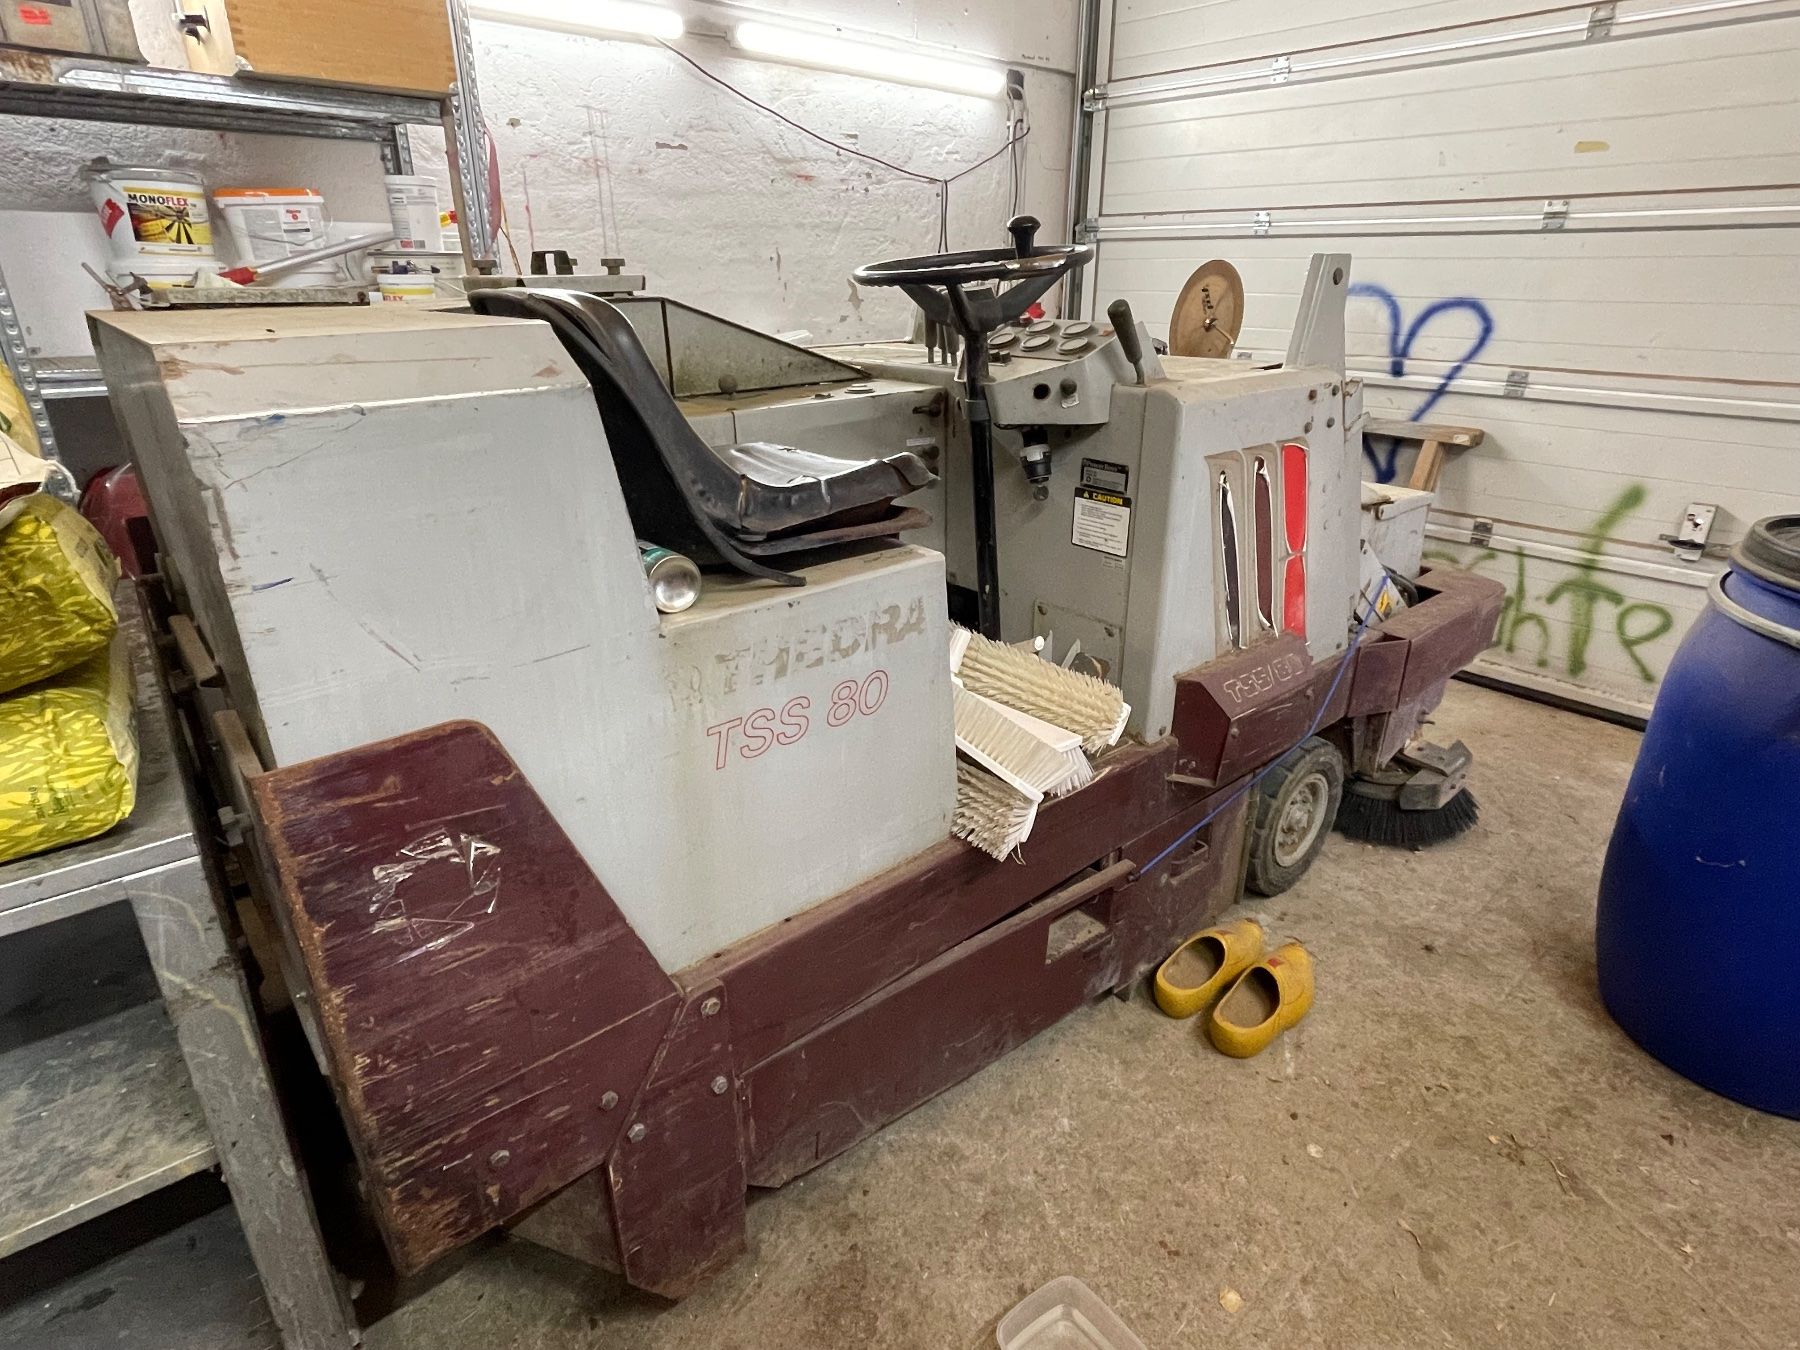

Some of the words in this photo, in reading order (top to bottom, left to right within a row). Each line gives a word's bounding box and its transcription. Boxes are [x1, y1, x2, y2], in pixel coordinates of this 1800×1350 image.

[127, 193, 189, 206] MONOFLEX
[1093, 492, 1123, 505] CAUTION
[706, 696, 811, 770] TSS
[826, 669, 889, 727] 80
